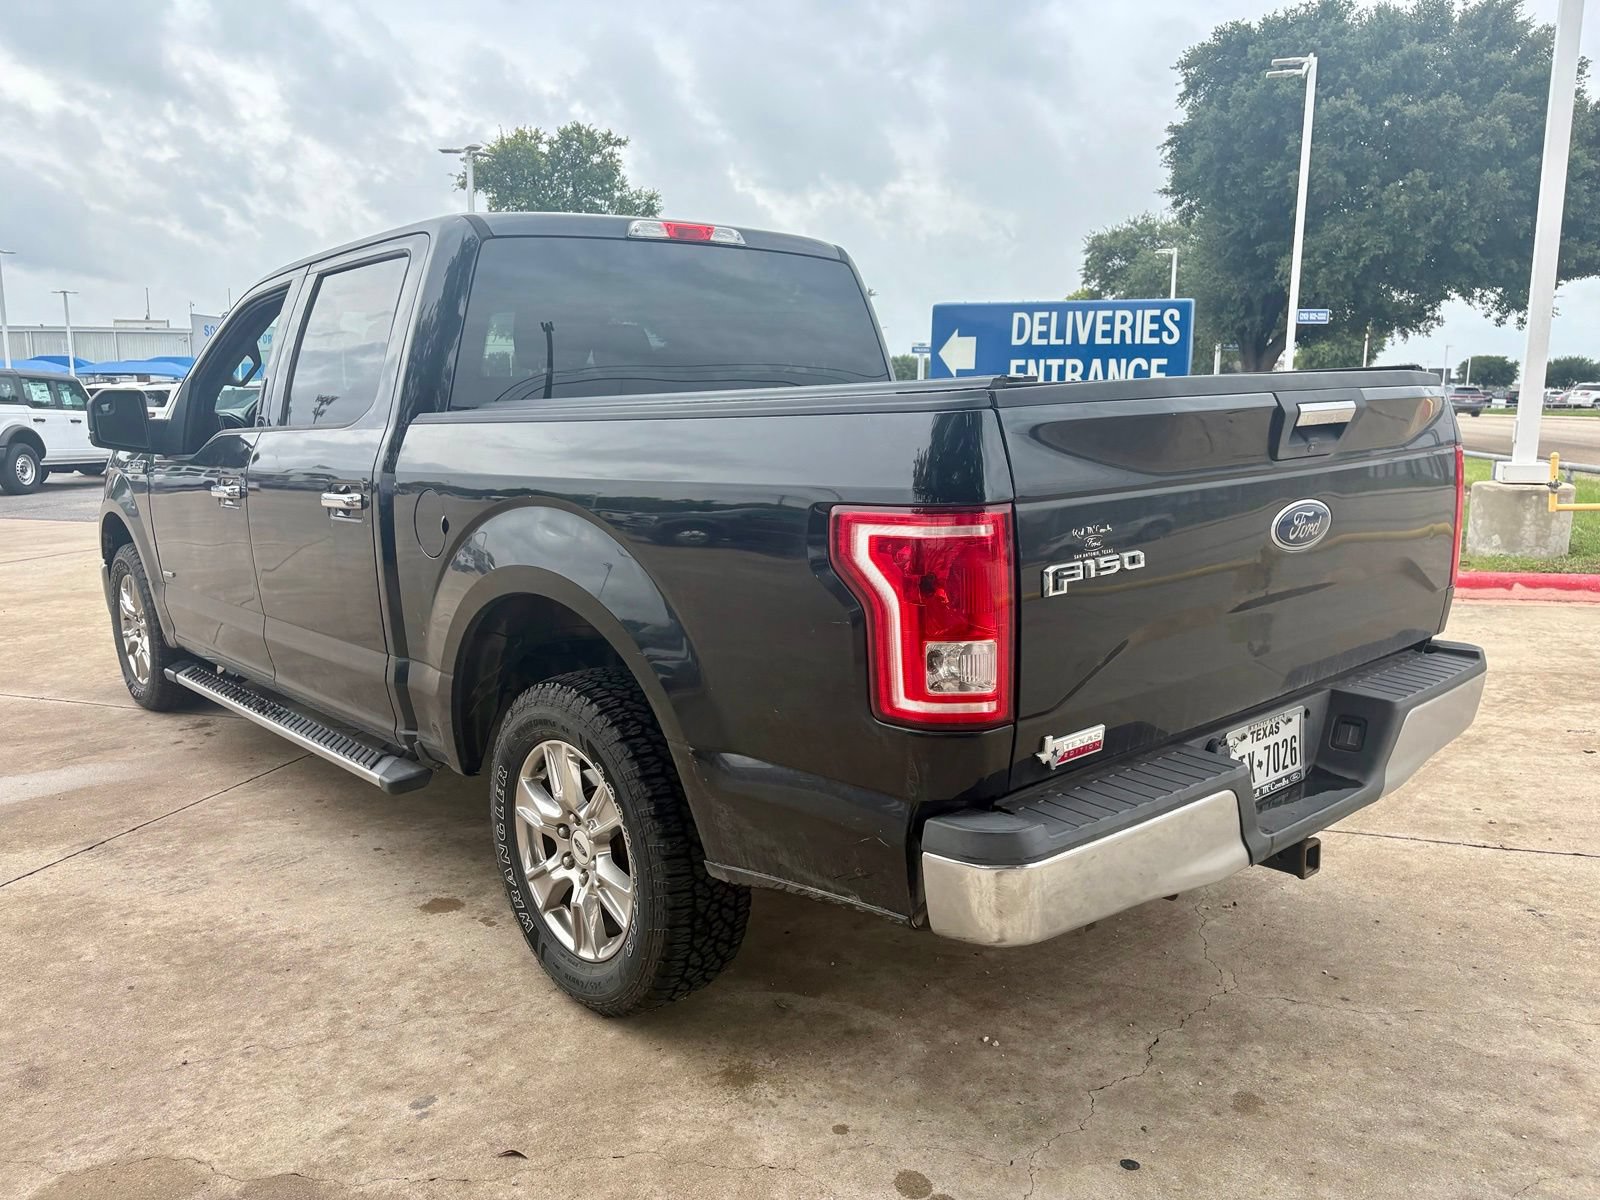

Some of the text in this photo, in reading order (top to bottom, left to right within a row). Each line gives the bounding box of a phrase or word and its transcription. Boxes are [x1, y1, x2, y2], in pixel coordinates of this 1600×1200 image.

[1011, 308, 1181, 346] DELIVERIES
[1009, 358, 1168, 382] ENTRANCE
[1289, 511, 1322, 540] Ford
[1064, 732, 1101, 750] TEXAS
[1249, 721, 1280, 744] TEXAS
[1064, 742, 1100, 758] EDITION
[1263, 735, 1298, 778] 7026
[495, 765, 534, 934] WRANGLER
